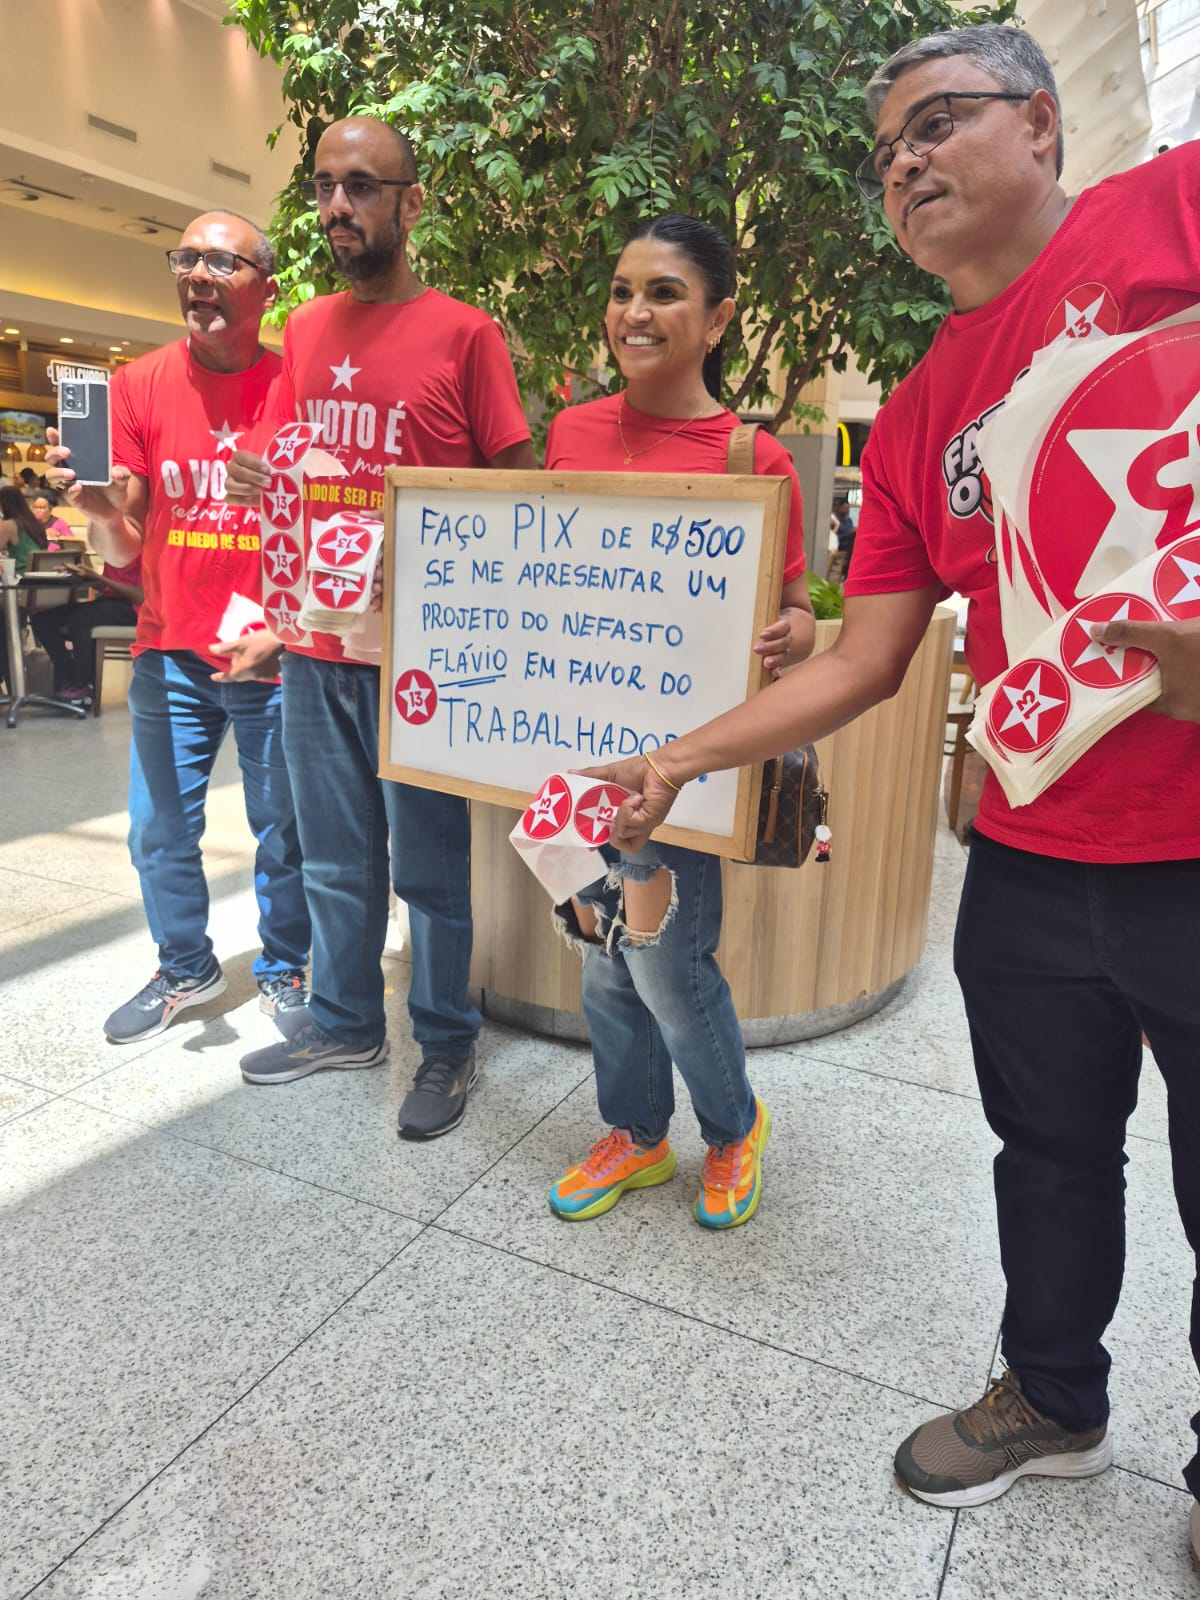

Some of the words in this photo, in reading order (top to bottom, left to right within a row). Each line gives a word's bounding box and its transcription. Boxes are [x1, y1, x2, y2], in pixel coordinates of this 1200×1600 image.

[306, 399, 377, 450] VOTO
[384, 400, 407, 456] É
[281, 440, 296, 452] 13
[160, 459, 185, 499] O
[275, 495, 288, 510] 13
[344, 486, 367, 507] SER
[420, 506, 487, 551] FAÇO
[601, 526, 633, 550] DE
[651, 515, 746, 558] R$500
[220, 533, 236, 550] DE
[237, 535, 260, 551] SER
[336, 537, 353, 548] 13
[276, 554, 288, 568] 13
[423, 558, 456, 589] SE
[471, 559, 504, 584] ME
[517, 561, 665, 594] APRESENTAR
[687, 569, 727, 601] UM
[278, 611, 292, 624] 13
[422, 602, 510, 632] PROJETO
[521, 611, 549, 632] DO
[562, 612, 684, 647] NEFASTO
[524, 651, 556, 680] EM
[569, 659, 646, 691] FAVOR
[660, 671, 693, 696] DO
[408, 690, 424, 707] 13
[1015, 690, 1042, 720] 13
[537, 797, 552, 815] 13
[596, 806, 614, 823] 13
